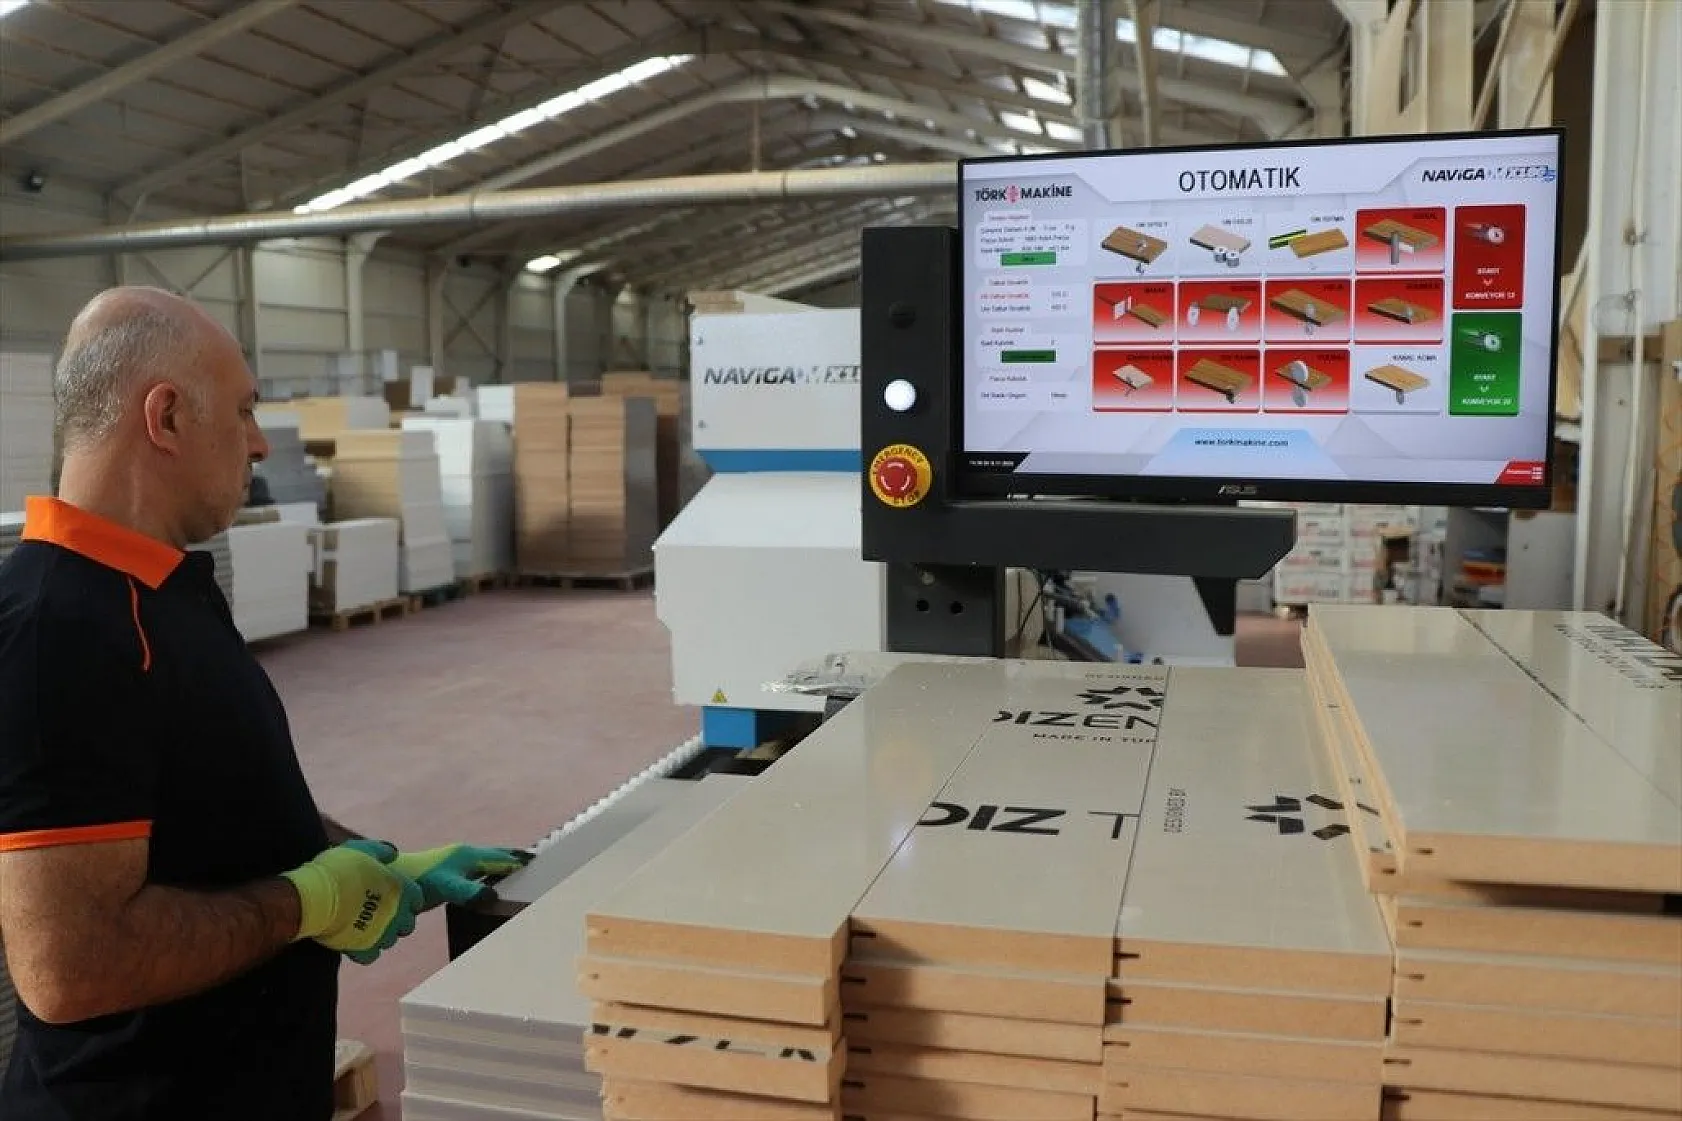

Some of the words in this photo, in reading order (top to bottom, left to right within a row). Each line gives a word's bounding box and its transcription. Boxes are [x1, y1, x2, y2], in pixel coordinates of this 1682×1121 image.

[1179, 166, 1301, 192] OTOMATIK
[974, 187, 1007, 202] TÖRK
[1021, 183, 1073, 199] MAKİNE
